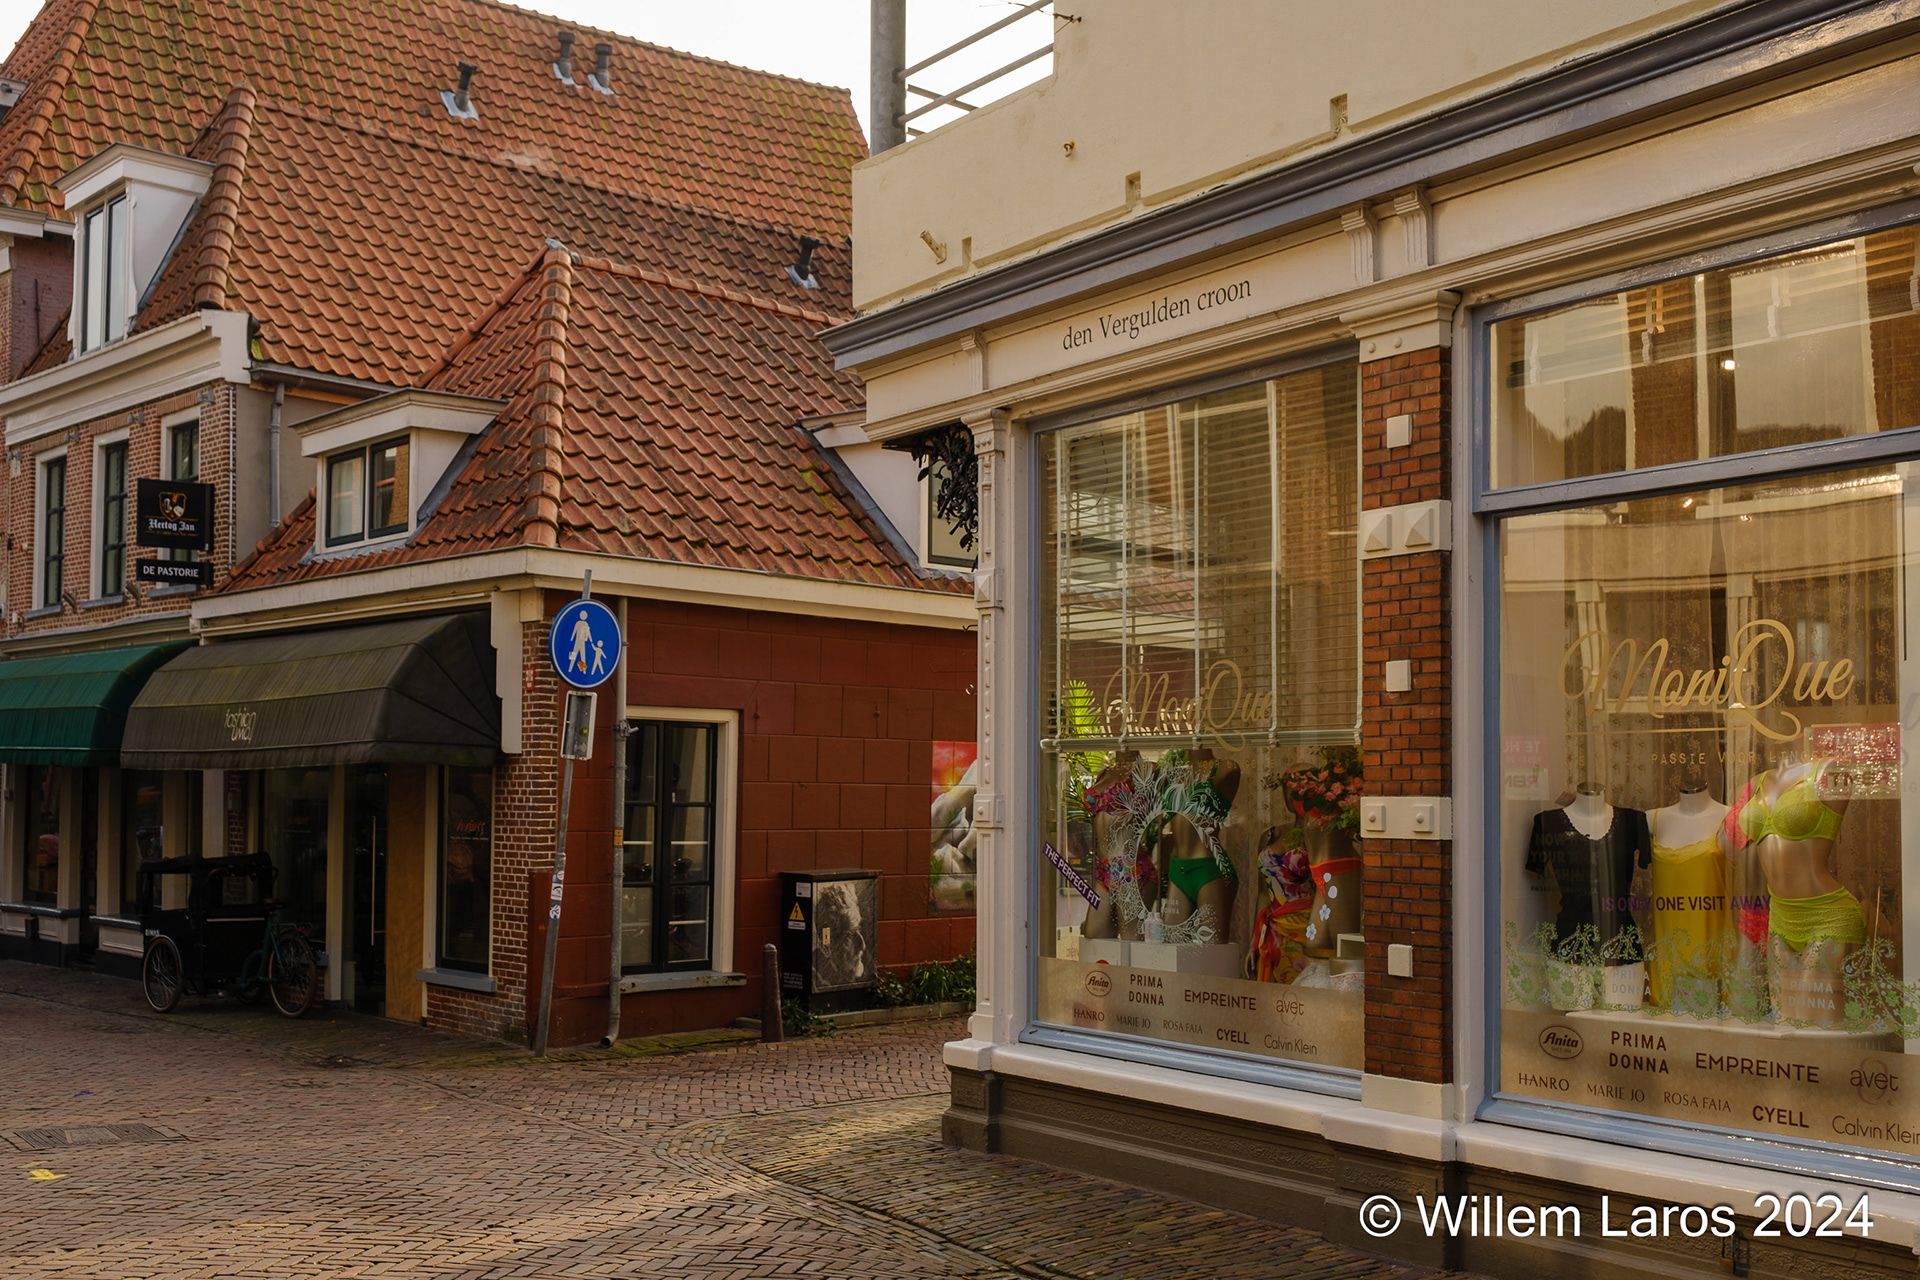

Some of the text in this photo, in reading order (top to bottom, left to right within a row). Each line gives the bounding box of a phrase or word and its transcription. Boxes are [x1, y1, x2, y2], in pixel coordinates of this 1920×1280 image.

[1062, 279, 1252, 350] den Vergulden croon
[148, 518, 196, 533] Hertog Jan
[143, 565, 200, 578] DE PASTORIE
[1557, 618, 1857, 742] MoniQue
[1651, 752, 1706, 765] PASSIE
[1717, 751, 1757, 764] VOOR
[1045, 843, 1101, 906] THE PERFECT FIT
[1601, 895, 1772, 912] IS ONLY ONE VISIT AWAY
[1087, 975, 1109, 988] Anita
[1129, 973, 1164, 989] PRIMA
[1789, 980, 1834, 994] PRIMA
[1128, 990, 1165, 1007] DONNA
[1184, 989, 1257, 1011] EMPREINTE
[1788, 996, 1836, 1010] DONNA
[1073, 1008, 1105, 1022] HANRO
[1276, 999, 1305, 1016] avet
[1116, 1015, 1151, 1030] MARIE JO
[1162, 1019, 1203, 1035] ROSA FAIA
[1216, 1028, 1250, 1045] CYELL
[1263, 1033, 1318, 1056] Calvin Klein
[1542, 1031, 1580, 1048] Anita
[1610, 1030, 1667, 1052] PRIMA
[1608, 1052, 1670, 1075] DONNA
[1695, 1052, 1820, 1084] EMPREINTE
[1518, 1072, 1571, 1092] HANRO
[1849, 1068, 1899, 1093] avet
[1586, 1082, 1646, 1103] MARIE JO
[1663, 1090, 1732, 1113] ROSA FAIA
[1752, 1104, 1810, 1129] CYELL
[1831, 1114, 1882, 1140] Calvin
